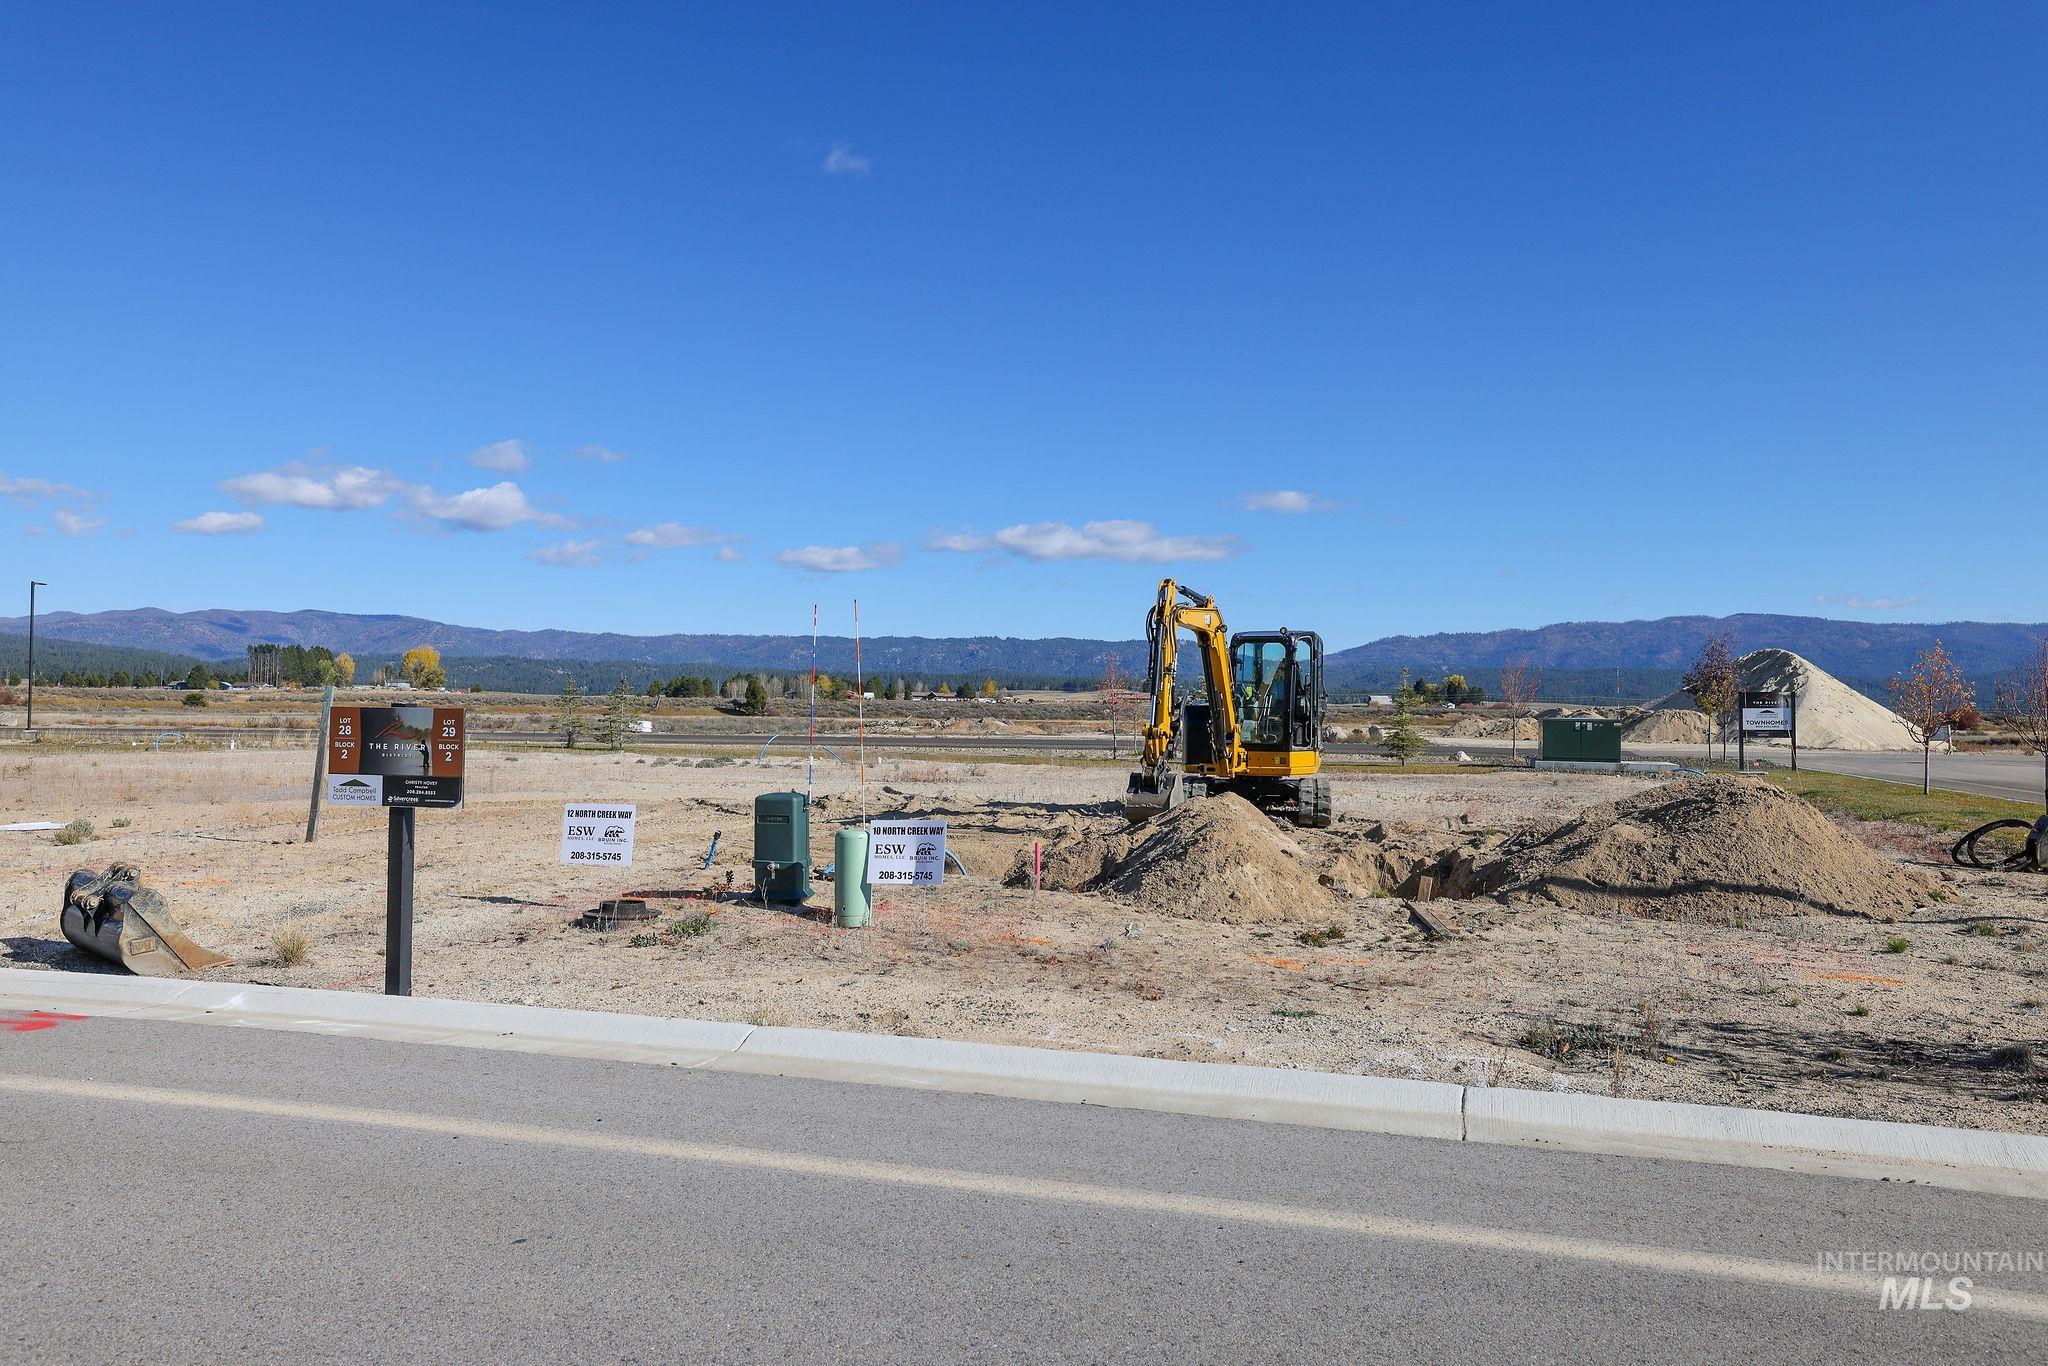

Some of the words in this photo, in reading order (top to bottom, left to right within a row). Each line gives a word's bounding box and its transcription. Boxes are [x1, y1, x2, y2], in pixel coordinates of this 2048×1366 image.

[338, 725, 352, 735] 28
[442, 727, 456, 737] 29
[369, 742, 388, 750] THE
[394, 743, 426, 751] RIVER
[341, 749, 348, 759] 2
[445, 751, 452, 762] 2
[348, 786, 377, 794] Campbell
[332, 793, 356, 801] CUSTOM
[356, 794, 377, 802] HOMES
[393, 795, 419, 803] Silvercreek
[567, 809, 575, 818] 12
[574, 809, 596, 818] NORTH
[597, 810, 616, 818] CREEK
[618, 810, 632, 819] WAY
[568, 826, 595, 835] ESW
[873, 826, 881, 835] 10
[882, 826, 906, 835] NORTH
[907, 826, 928, 835] CREEK
[929, 826, 944, 835] WAY
[874, 843, 906, 854] ESW
[570, 851, 622, 861] 208-315-5745
[878, 871, 933, 880] 208-315-5745
